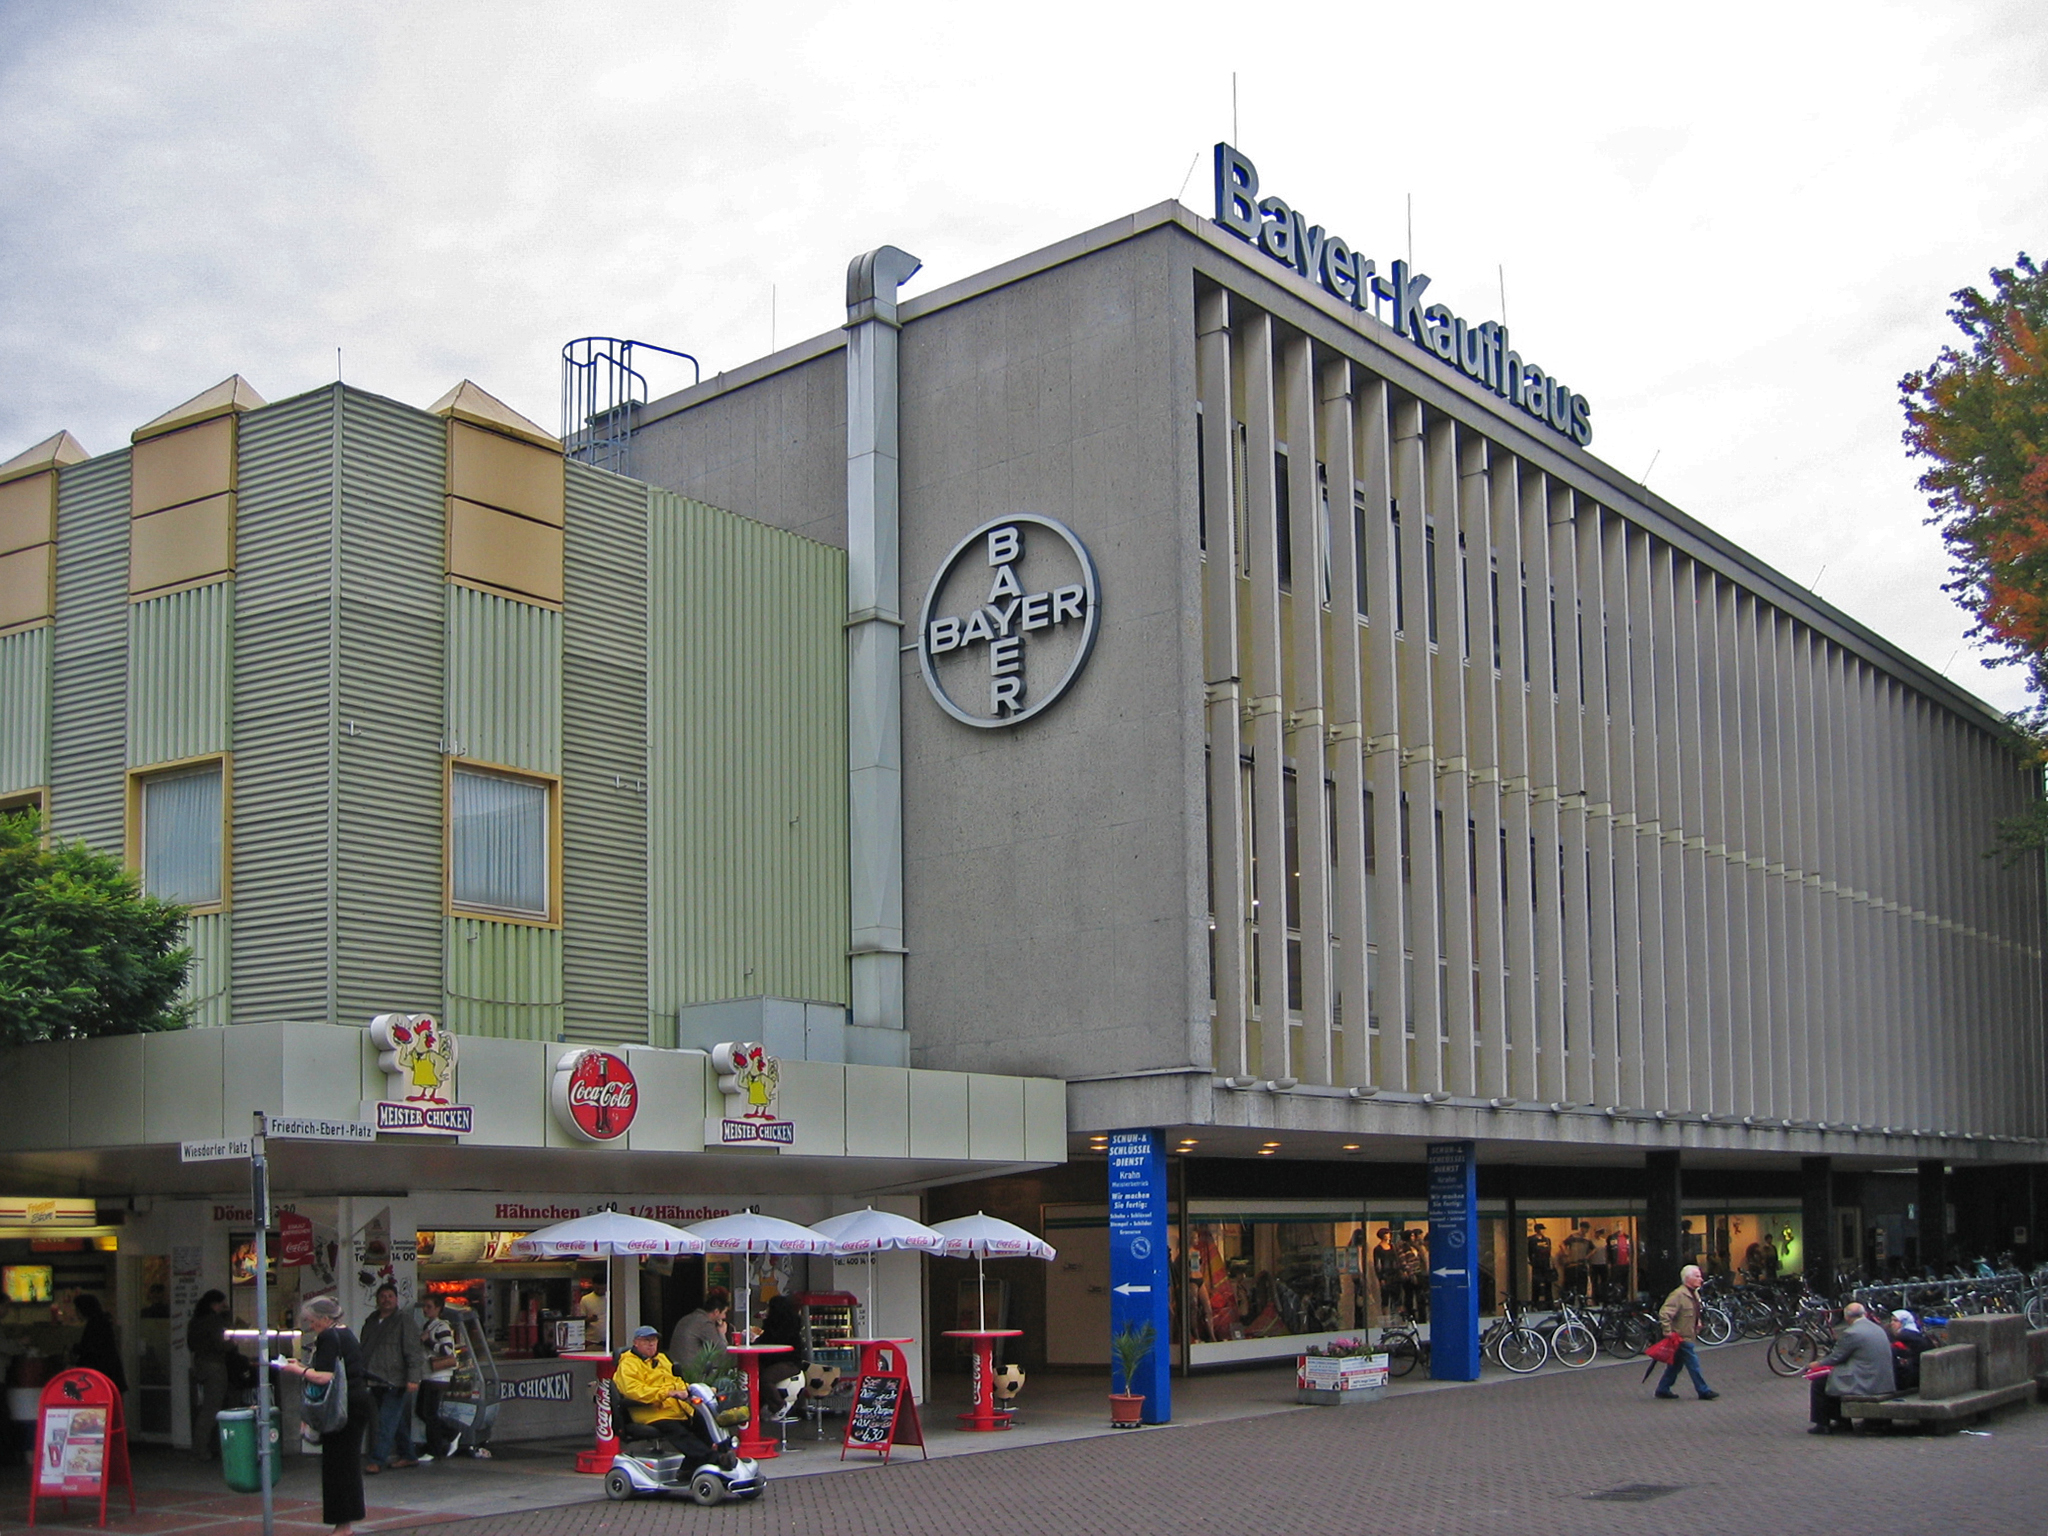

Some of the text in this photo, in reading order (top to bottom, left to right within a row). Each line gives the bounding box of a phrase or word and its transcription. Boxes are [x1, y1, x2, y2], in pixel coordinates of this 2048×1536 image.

[1214, 142, 1592, 447] Bayer-Kaufhaus
[930, 584, 1086, 656] BAYER
[986, 526, 1026, 716] BAYER
[570, 1079, 635, 1109] Coca-Cola
[379, 1104, 471, 1130] MEISTER CHICKEN
[271, 1119, 372, 1138] Friedrich-Ebert-Platz
[723, 1121, 793, 1142] MEISTER CHICKEN
[183, 1142, 248, 1158] Wiesdorfer Platz
[1109, 1144, 1151, 1155] SCHLÜSSEL
[1119, 1171, 1141, 1179] Krahn
[1124, 1191, 1150, 1199] machen
[495, 1203, 581, 1219] Hähnchen
[1125, 1201, 1148, 1210] fertig:
[212, 1204, 254, 1221] Döne
[556, 1240, 586, 1250] Coca-Cola
[627, 1239, 658, 1250] Coca-Cola
[710, 1238, 741, 1248] Coca-Cola
[780, 1239, 805, 1249] Coca-Cola
[842, 1239, 871, 1250] Coca-Cola
[906, 1236, 929, 1245] Coca-Cola
[996, 1239, 1021, 1249] Coca-Cola
[403, 1253, 416, 1261] 00
[518, 1371, 570, 1400] CHICKEN
[596, 1378, 614, 1441] Coca-Cola
